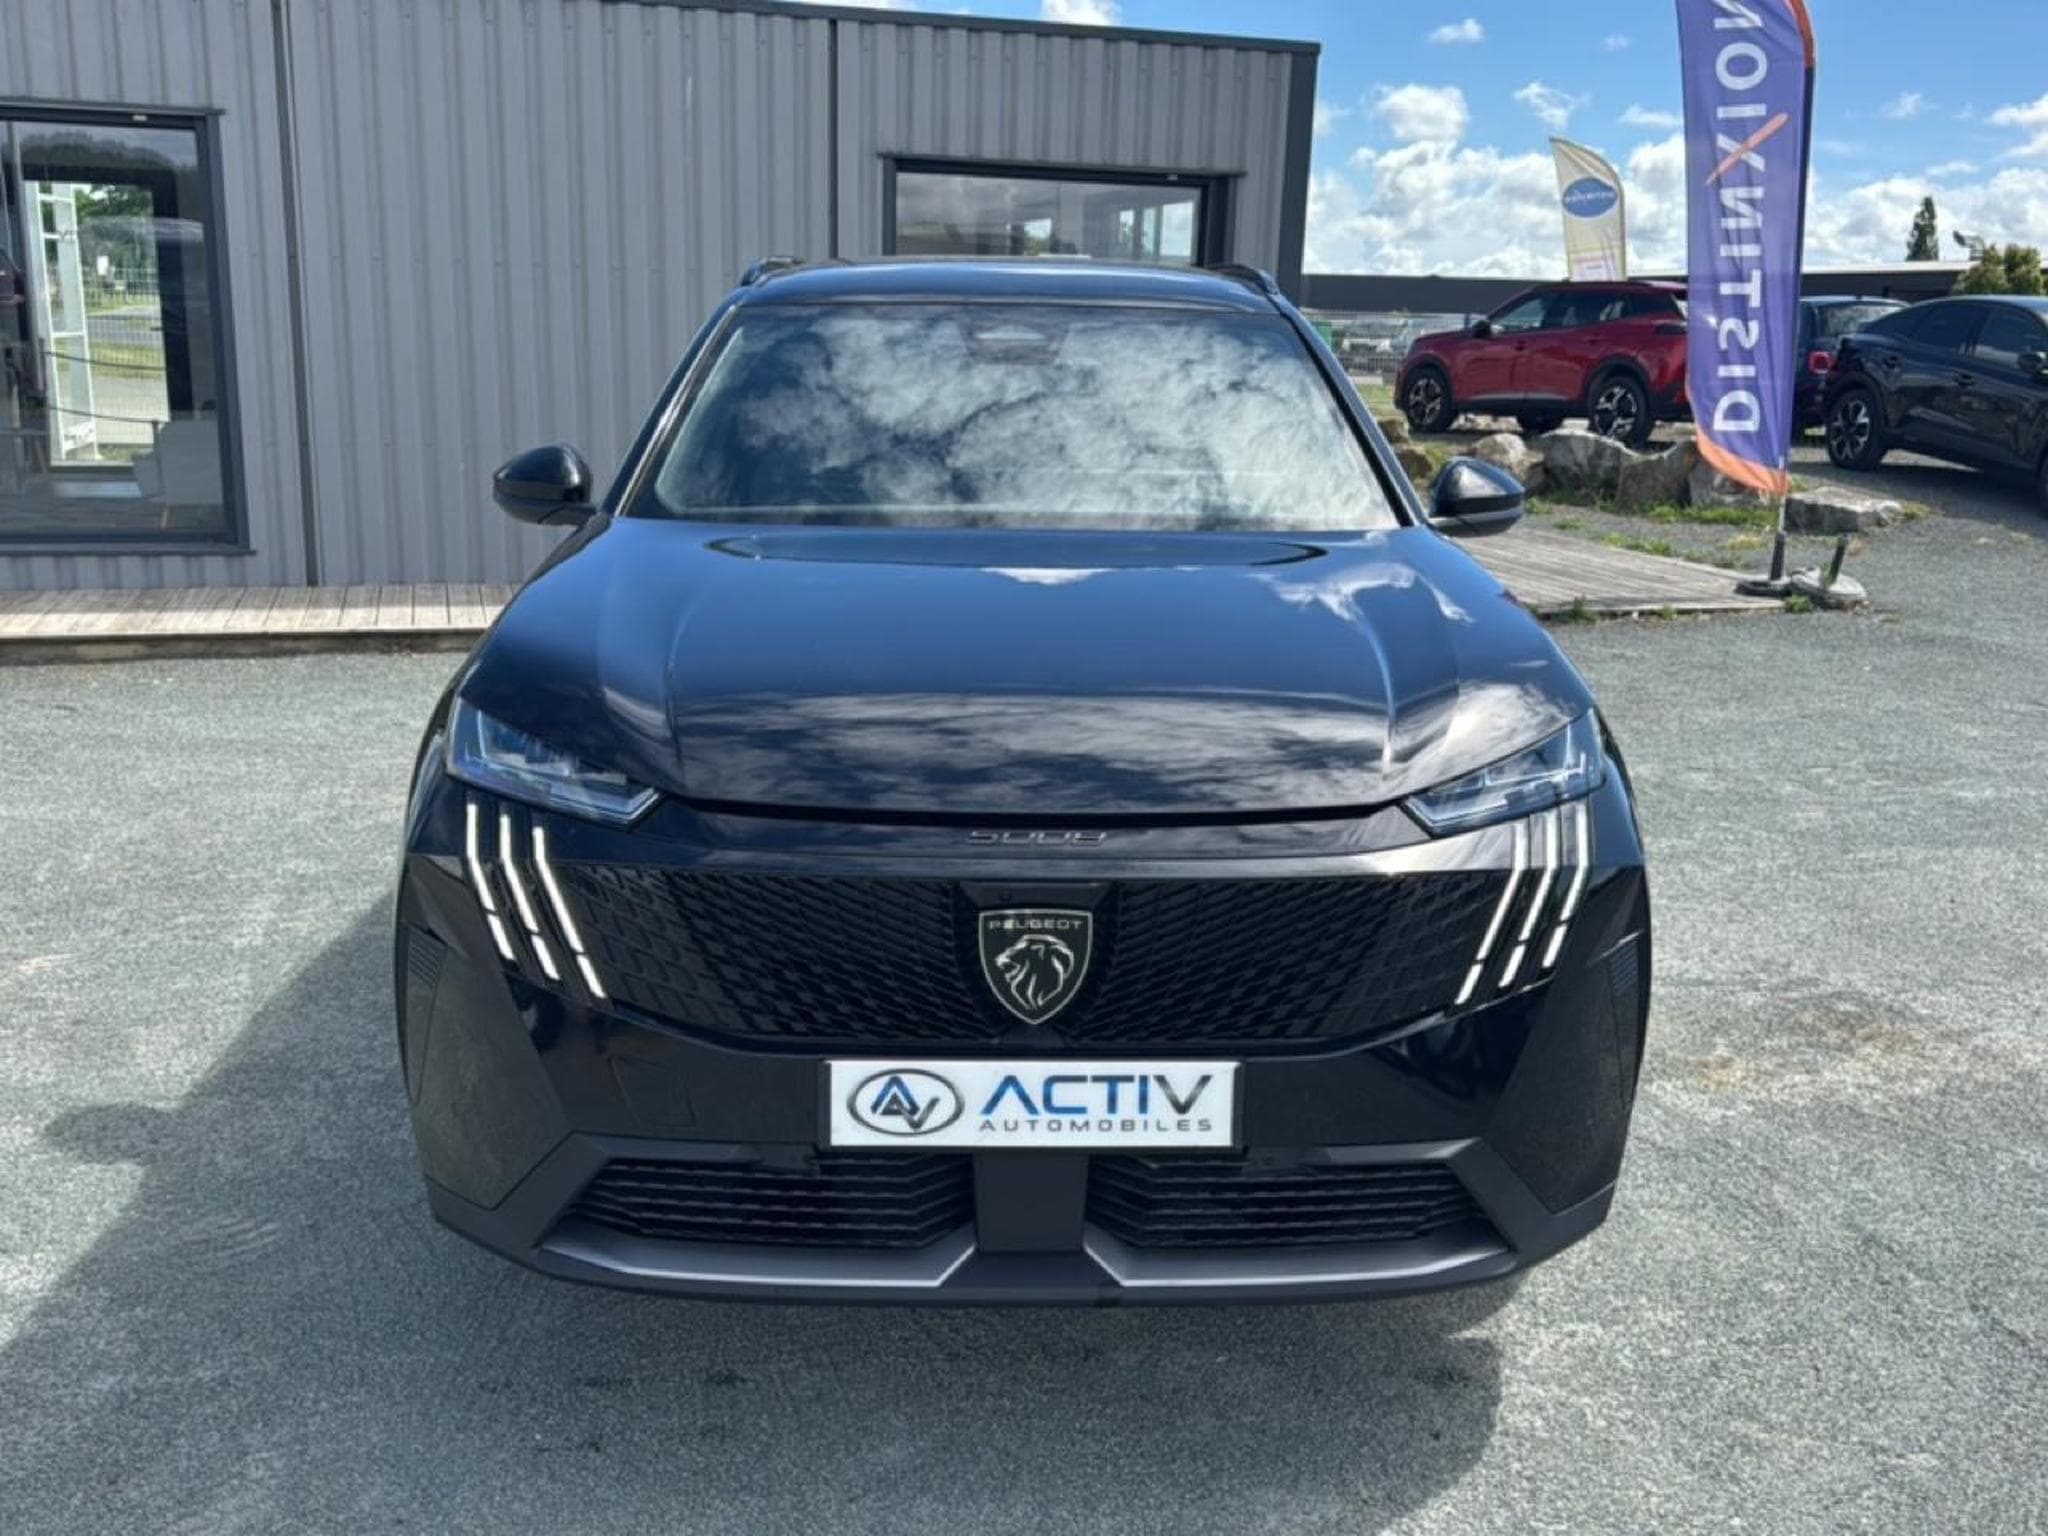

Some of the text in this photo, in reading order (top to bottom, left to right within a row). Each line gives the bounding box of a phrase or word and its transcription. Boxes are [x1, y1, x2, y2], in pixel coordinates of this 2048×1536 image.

[989, 918, 1084, 930] PEUGEOT
[980, 1074, 1213, 1115] ACTIV
[979, 1118, 1213, 1133] AUTOMOBILES
